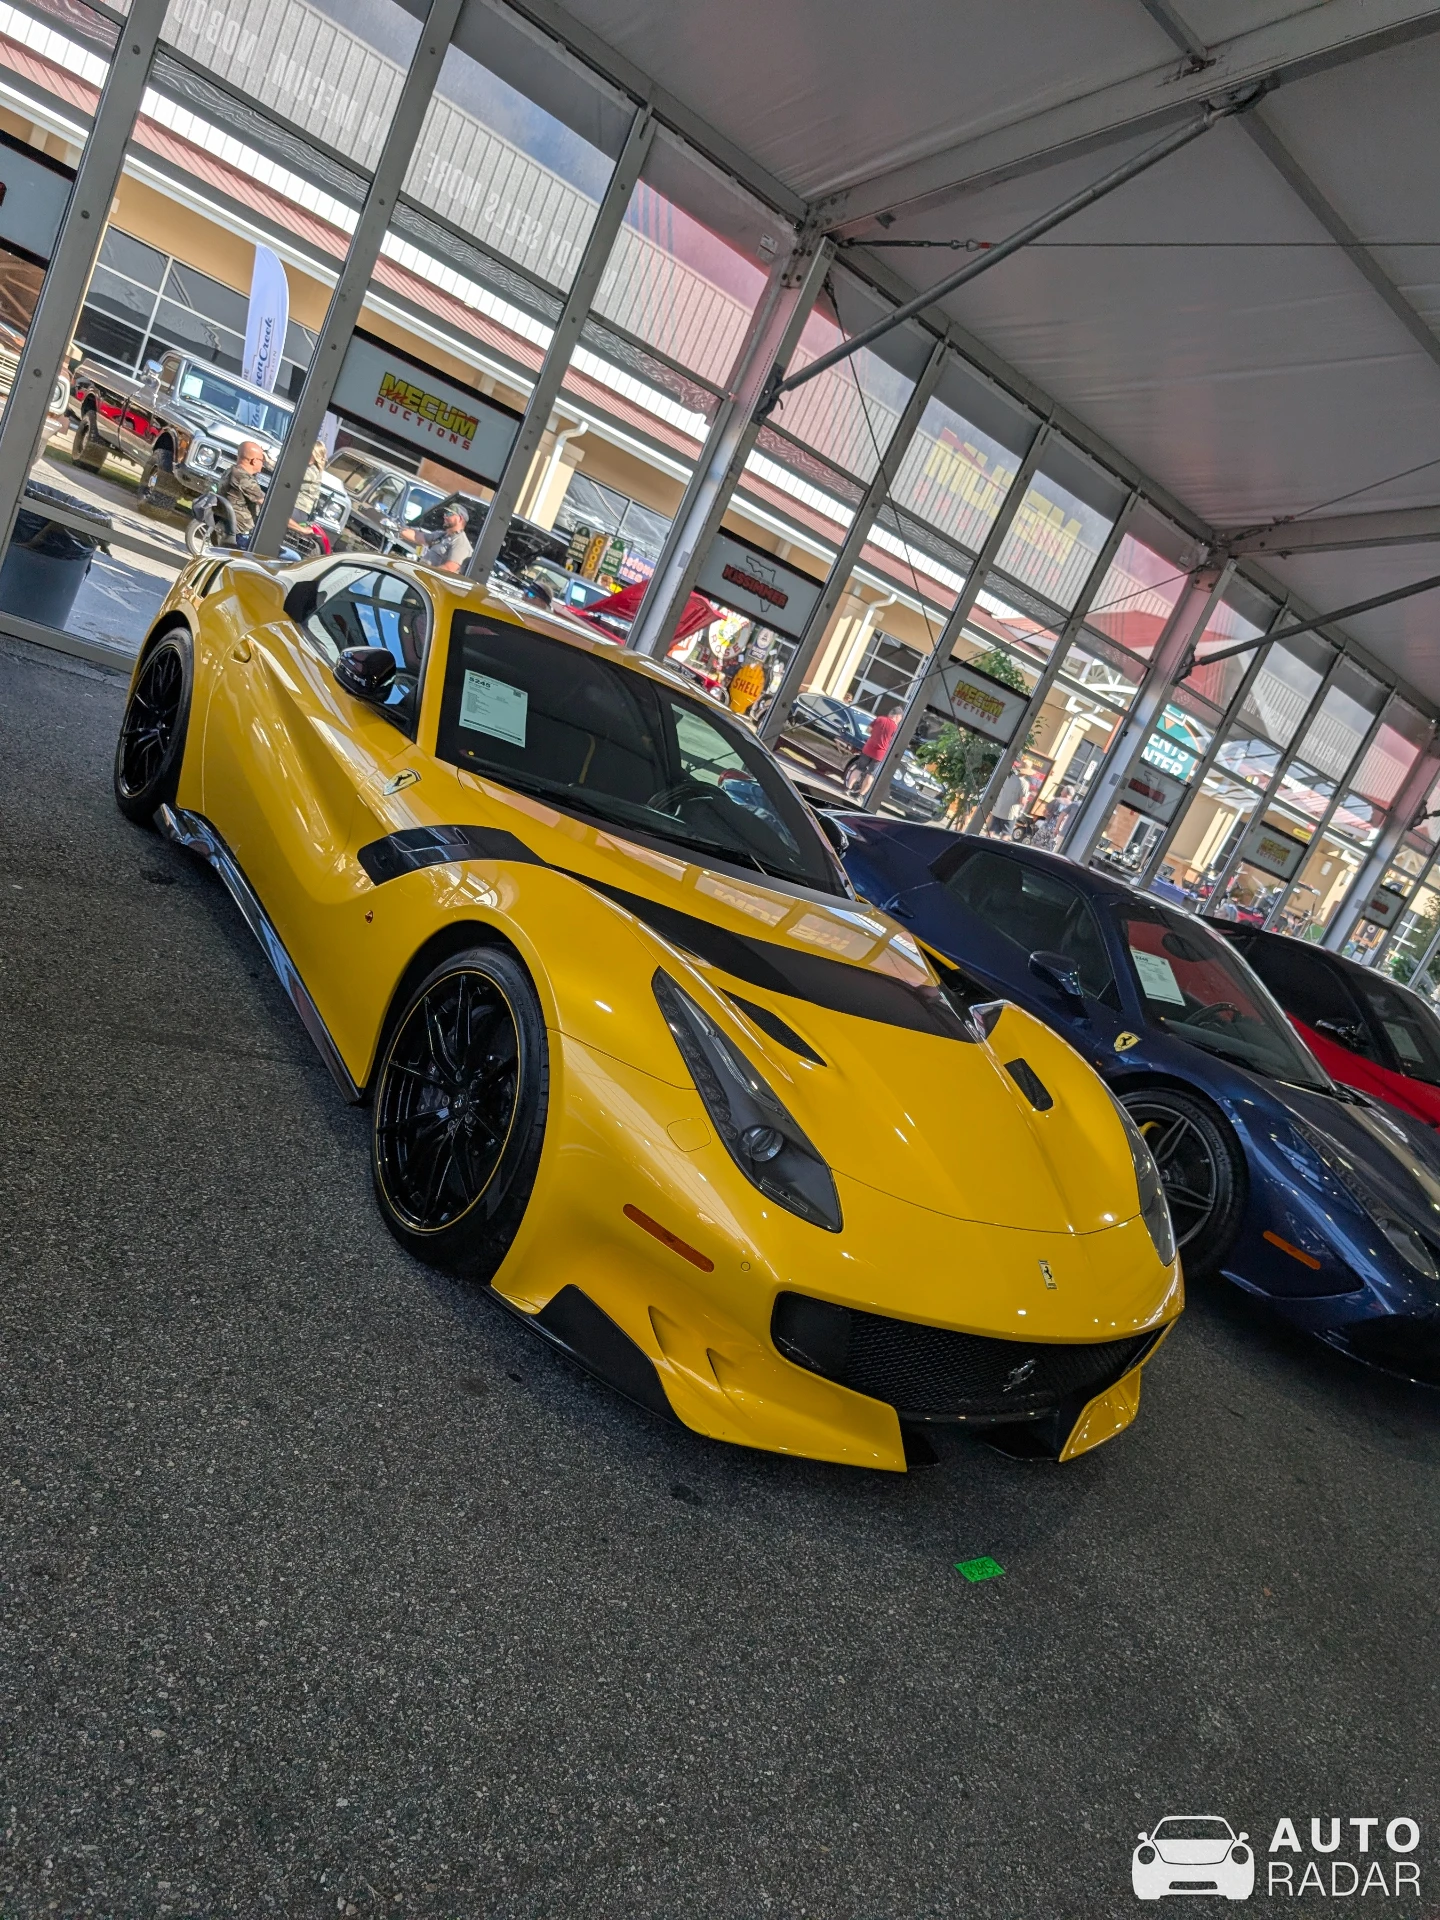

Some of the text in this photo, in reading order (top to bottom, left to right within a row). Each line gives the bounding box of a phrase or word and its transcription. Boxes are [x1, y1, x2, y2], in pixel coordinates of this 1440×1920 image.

[378, 371, 481, 441] MECUM
[374, 396, 472, 451] AUCTIONS
[733, 677, 760, 698] SHELL
[953, 679, 1006, 719] MECUM
[950, 696, 999, 724] AUCTIONS
[1141, 746, 1183, 776] NTER
[1148, 732, 1189, 761] ENTS
